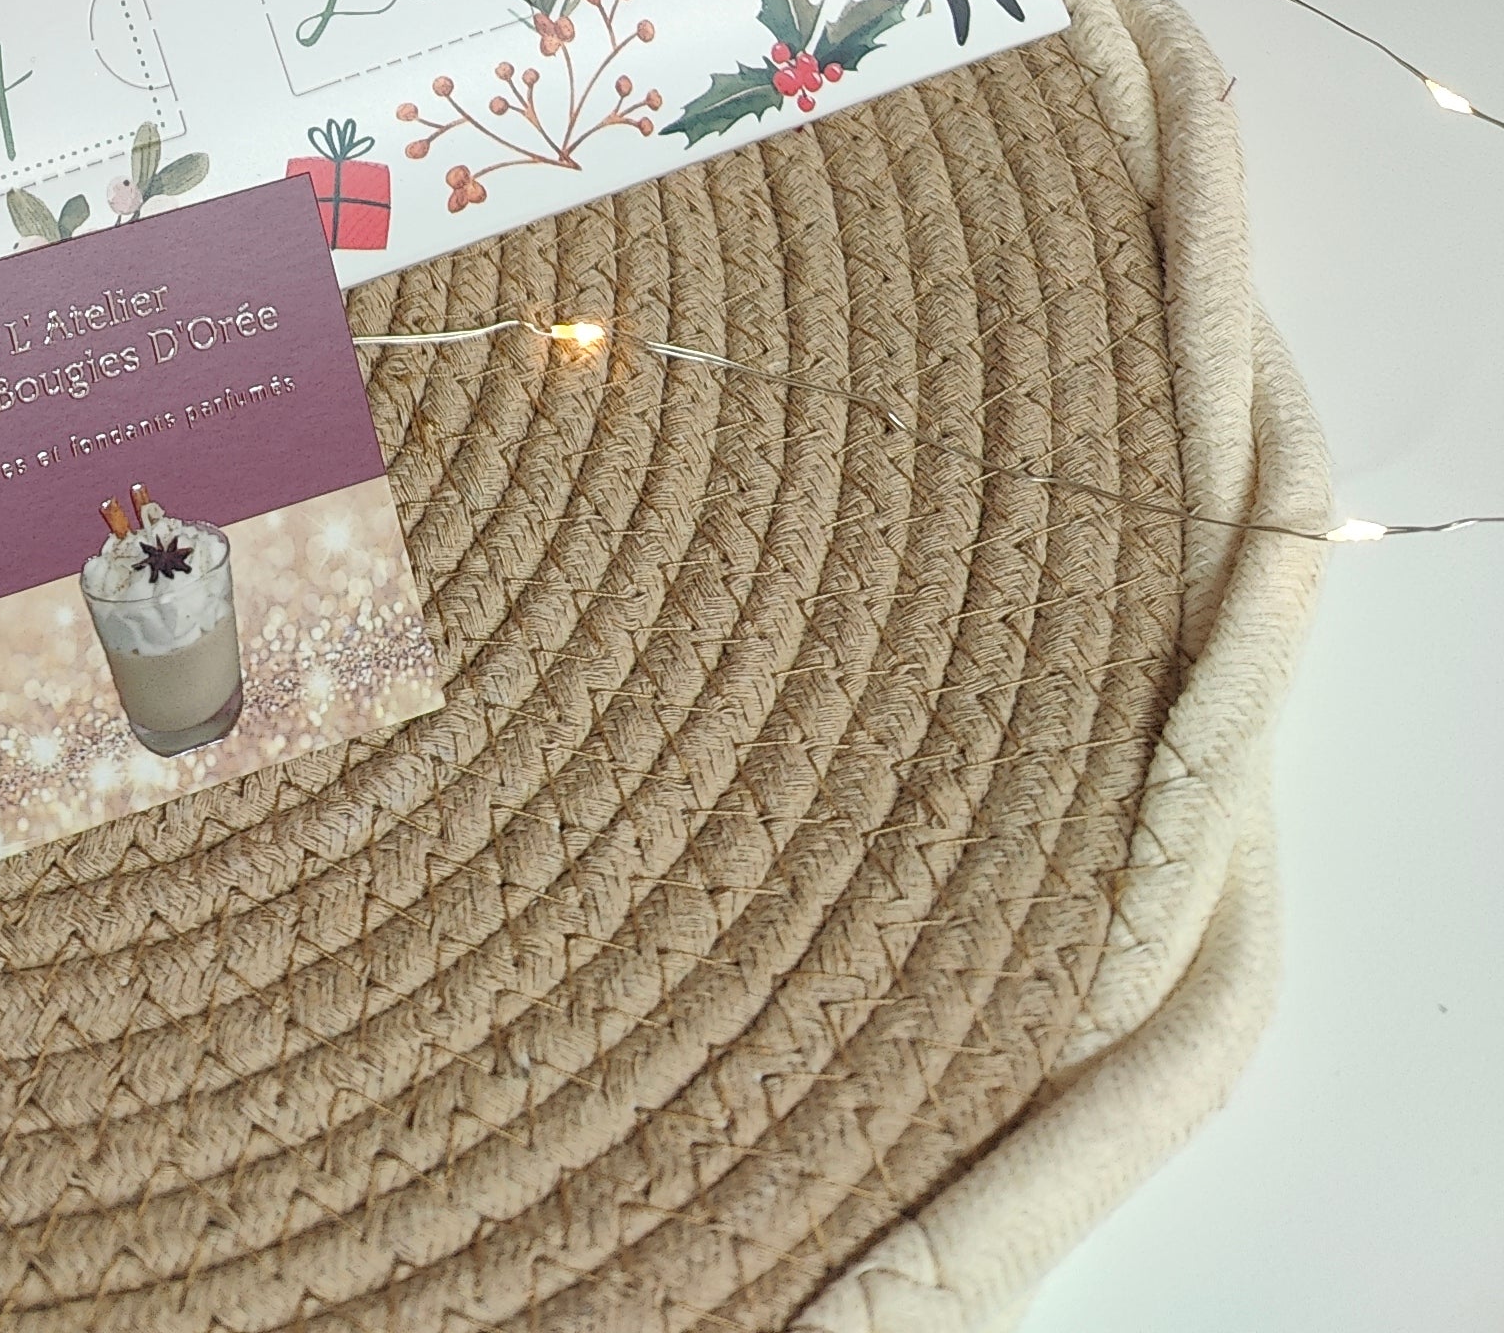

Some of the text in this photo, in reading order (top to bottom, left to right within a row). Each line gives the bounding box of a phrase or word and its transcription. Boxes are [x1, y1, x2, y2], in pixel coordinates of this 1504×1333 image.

[2, 285, 170, 356] L'Atelier
[145, 301, 280, 365] D'Orée
[68, 410, 177, 458] fondants
[184, 374, 297, 429] parfumés
